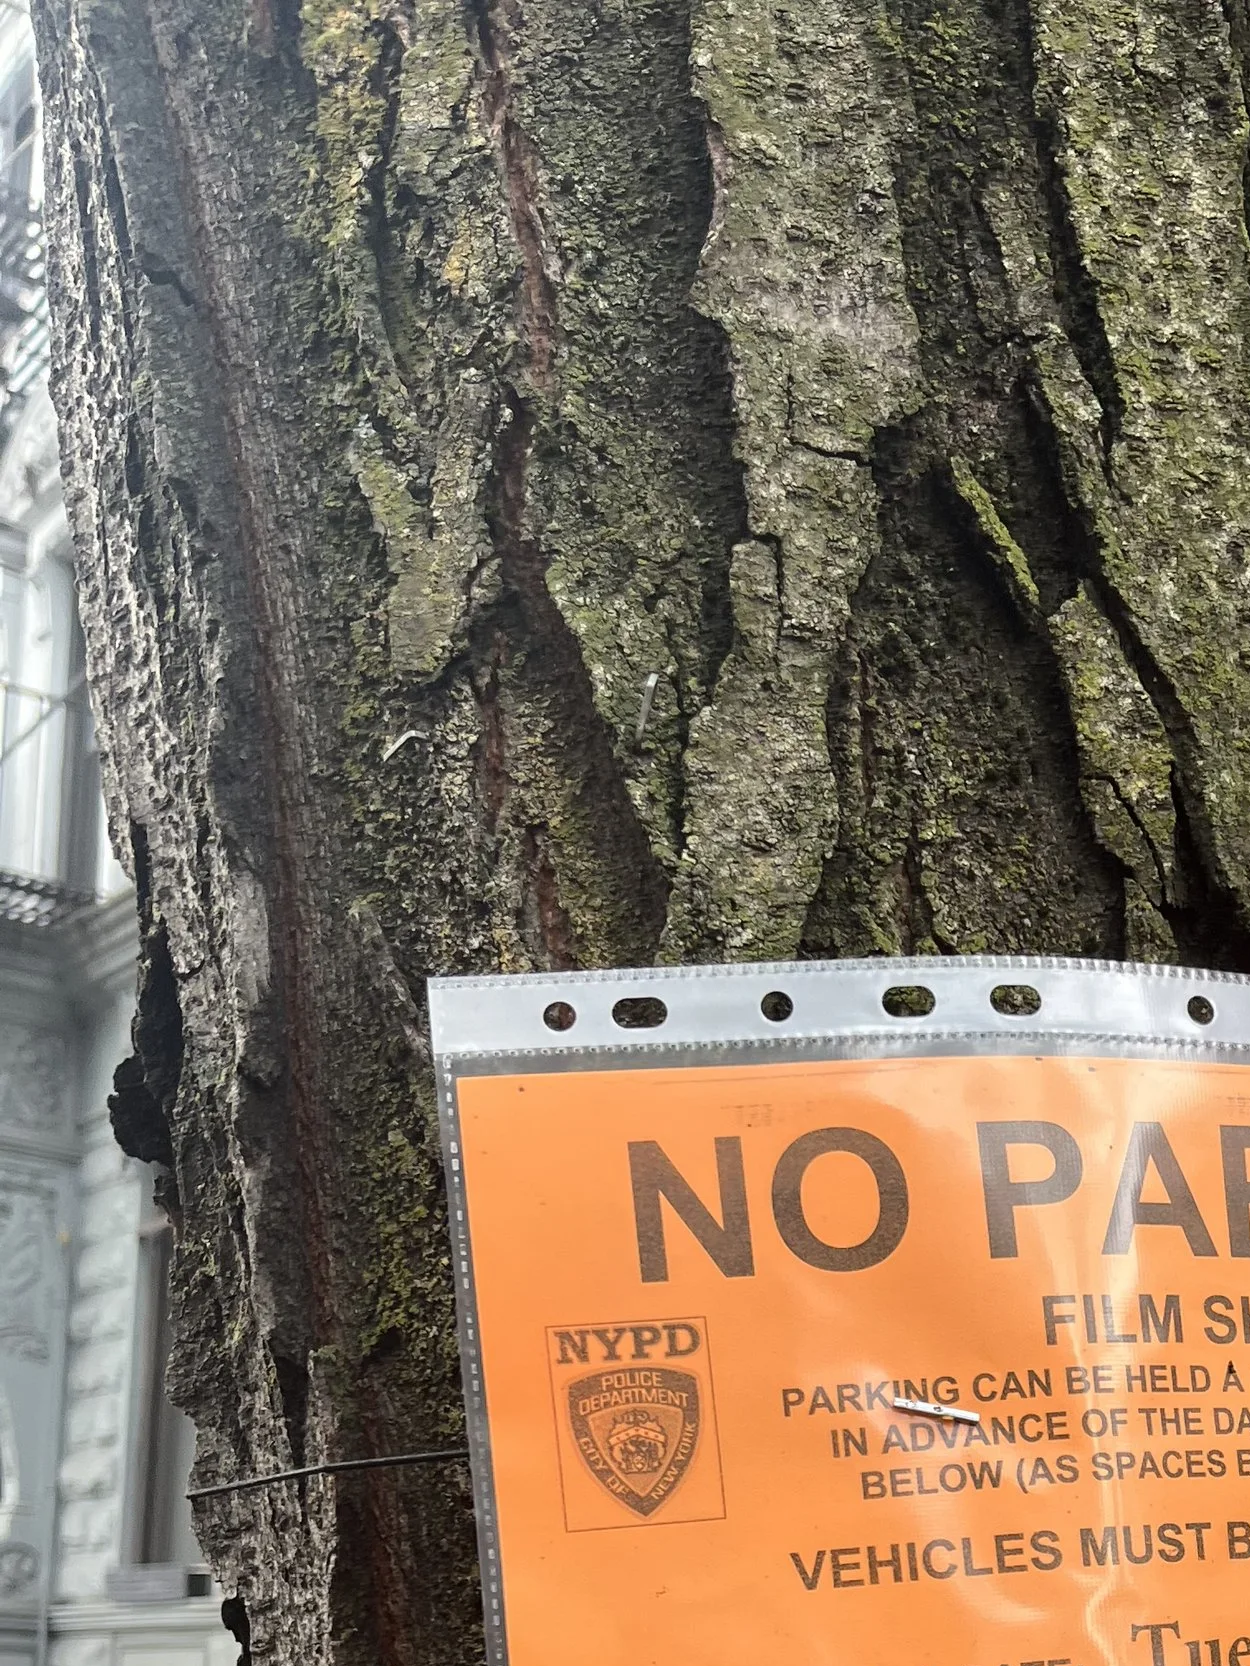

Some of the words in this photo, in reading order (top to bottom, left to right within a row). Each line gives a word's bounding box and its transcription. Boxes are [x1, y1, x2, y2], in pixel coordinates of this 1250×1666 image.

[627, 1126, 910, 1284] NO
[554, 1324, 700, 1364] NYPD
[1041, 1293, 1184, 1346] FILM
[578, 1387, 689, 1416] DEPARTMENT
[600, 1371, 664, 1391] POLICE
[781, 1375, 960, 1418] PARKING
[972, 1368, 1053, 1403] CAN
[1065, 1365, 1115, 1395] BE
[1125, 1364, 1212, 1393] HELD
[1222, 1360, 1245, 1393] A
[830, 1427, 869, 1459] IN
[881, 1406, 1071, 1455] ADVANCE
[1081, 1408, 1128, 1438] OF
[1137, 1407, 1205, 1436] THE
[576, 1436, 608, 1471] CITY
[606, 1475, 630, 1496] OF
[651, 1465, 680, 1500] NEW
[674, 1422, 697, 1463] YORK
[860, 1460, 1003, 1501] BELOW
[1016, 1454, 1080, 1495] (AS
[1091, 1449, 1227, 1481] SPACES
[789, 1530, 1063, 1591] VEHICLES
[1079, 1521, 1212, 1568] MUST
